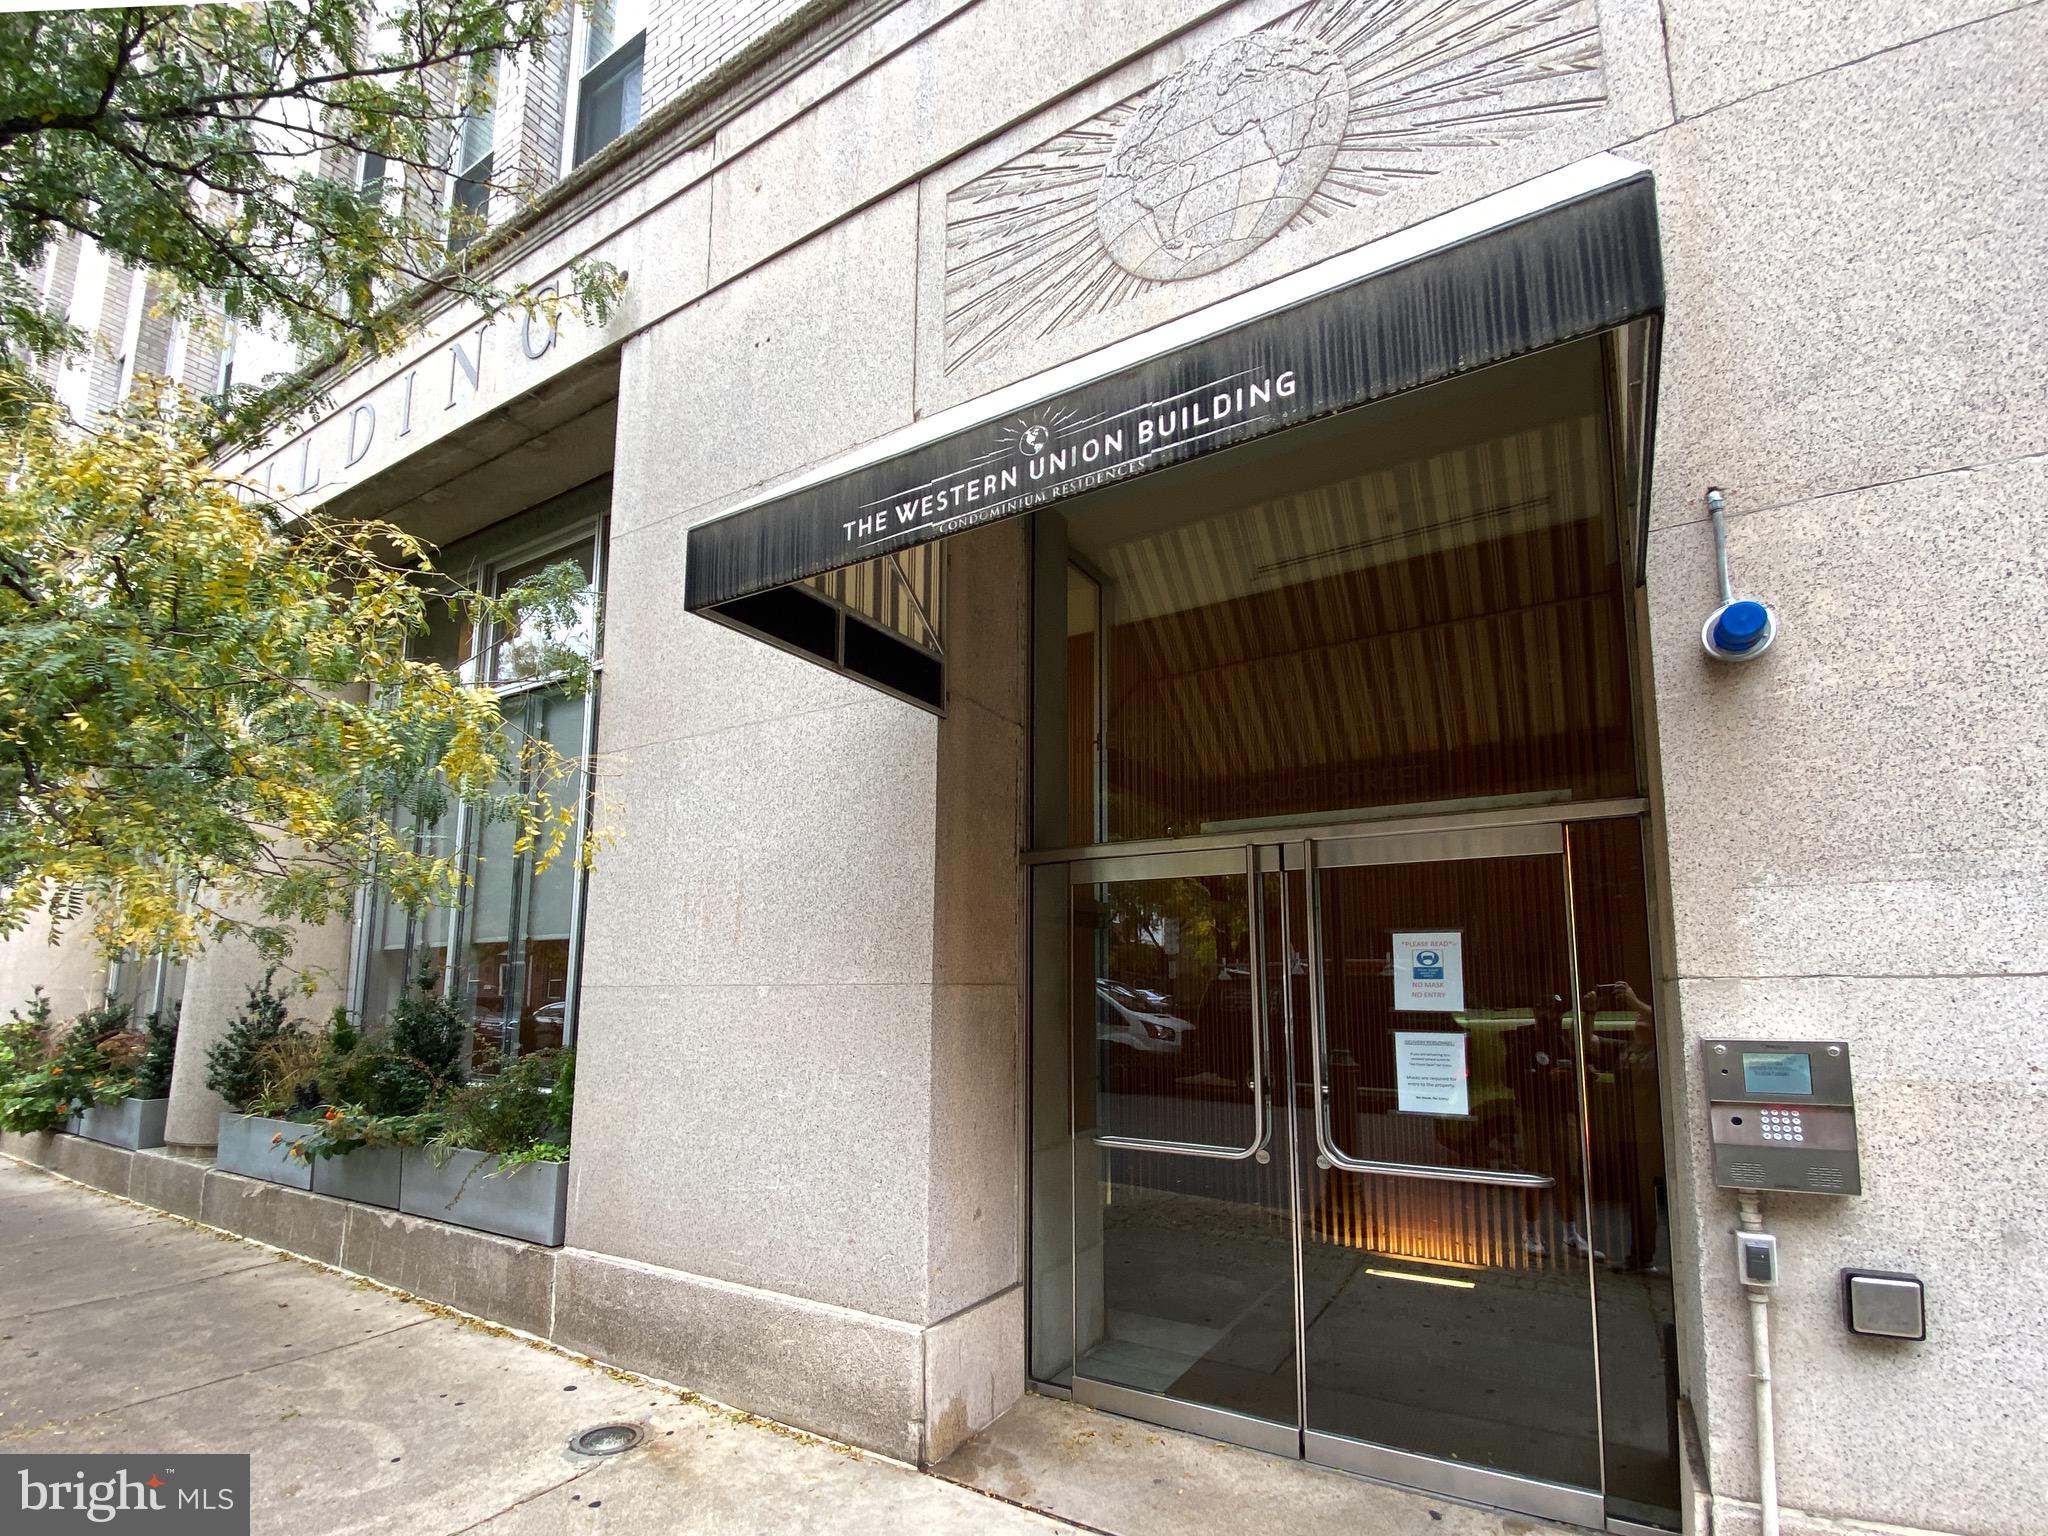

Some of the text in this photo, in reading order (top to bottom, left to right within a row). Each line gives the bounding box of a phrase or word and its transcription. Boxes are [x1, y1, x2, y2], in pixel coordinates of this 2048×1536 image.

[842, 370, 1297, 541] THE WESTERN UNION BUILDING
[939, 460, 1146, 534] CONDOMINIUM RESIDENCES
[1332, 763, 1430, 796] STREET
